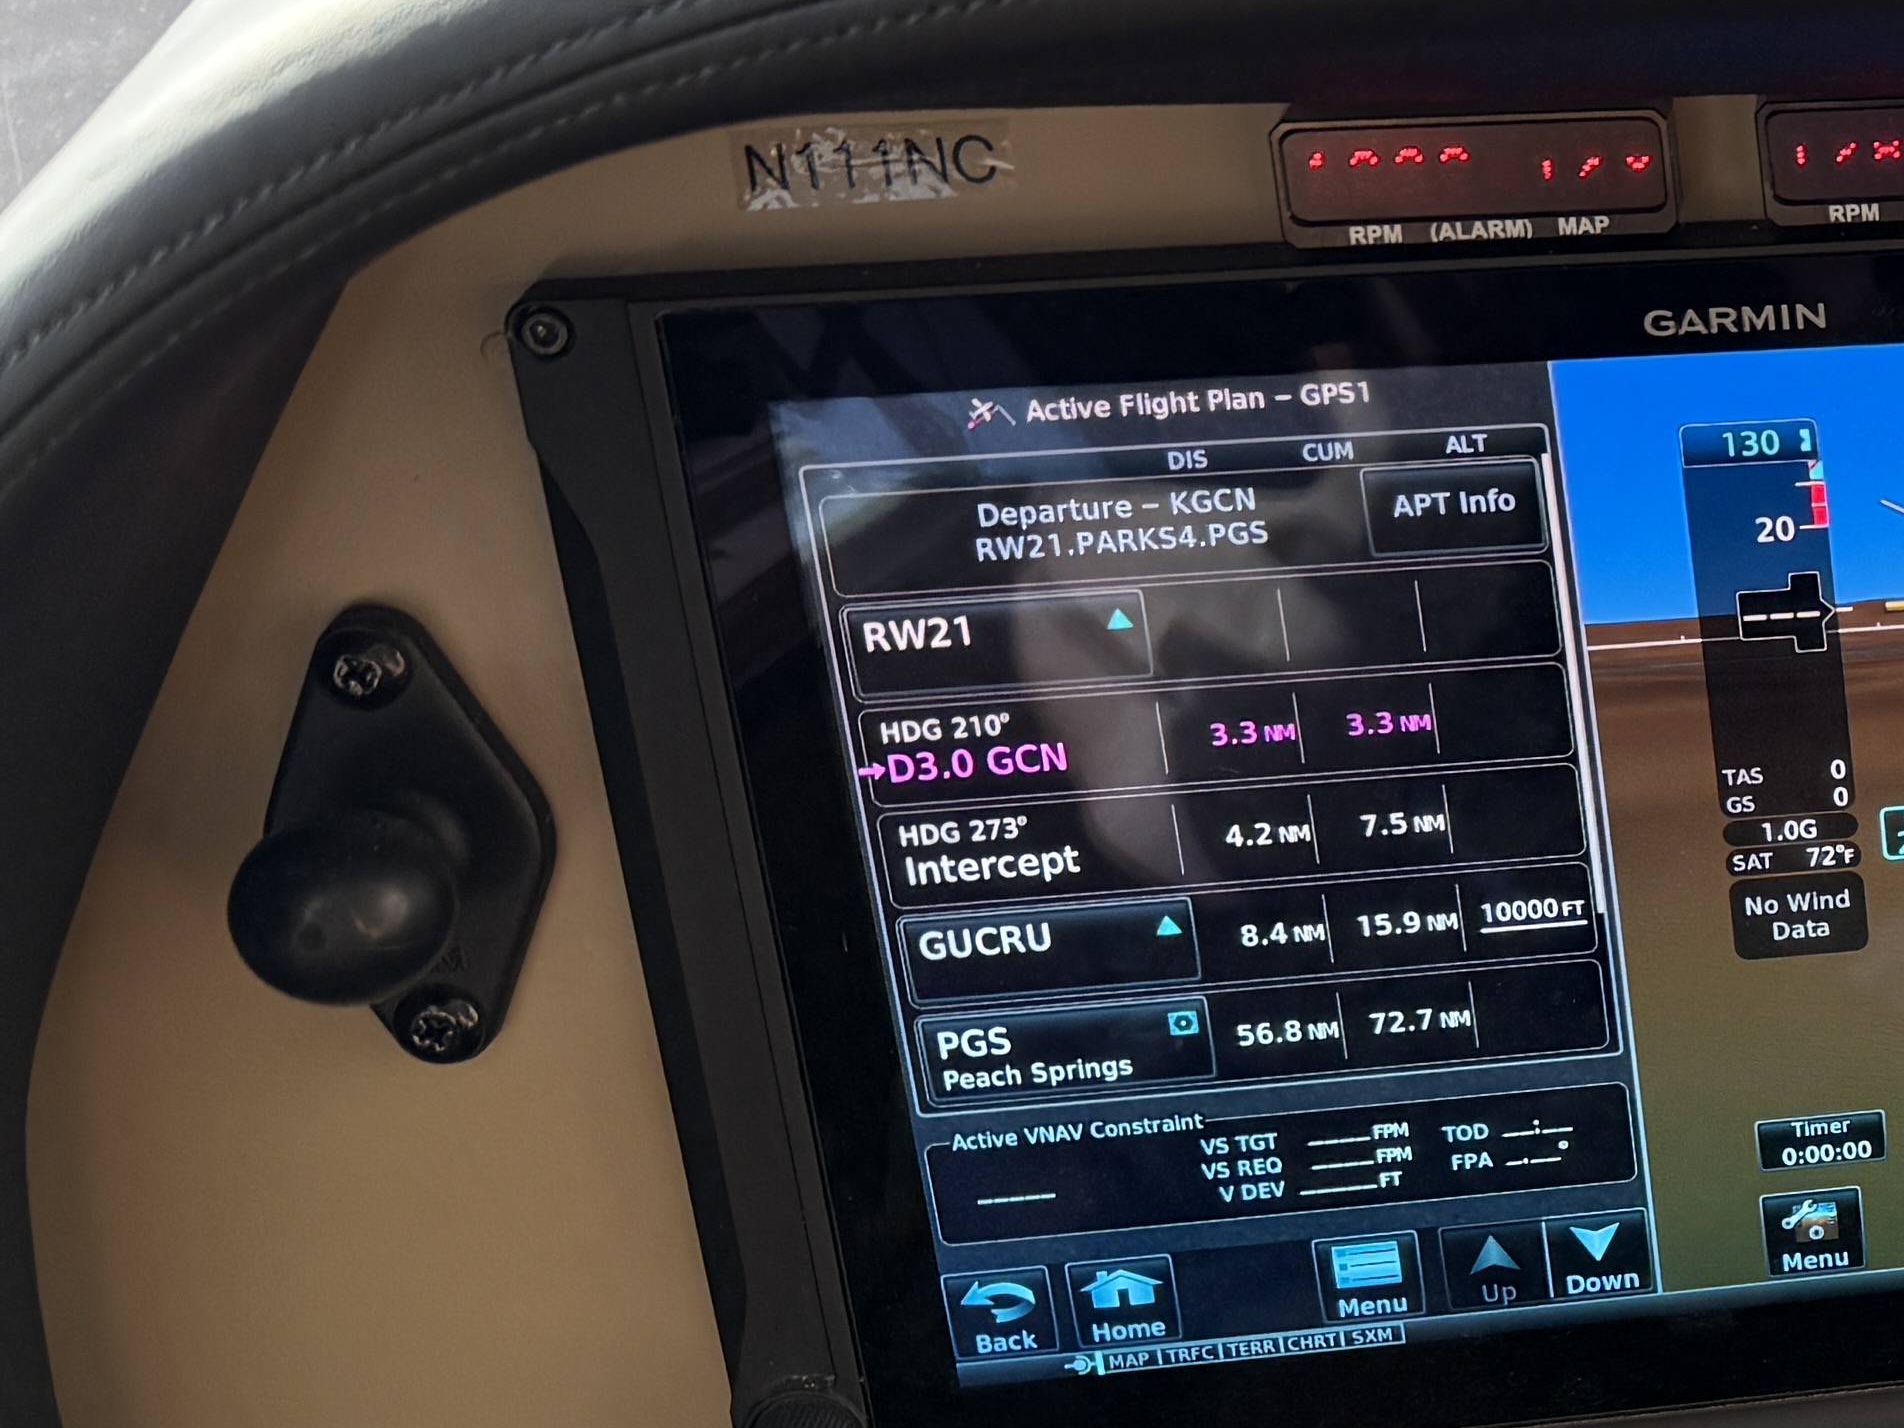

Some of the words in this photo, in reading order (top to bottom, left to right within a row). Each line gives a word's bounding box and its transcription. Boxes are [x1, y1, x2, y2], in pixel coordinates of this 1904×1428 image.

[743, 136, 1000, 195] N111NC
[1829, 203, 1880, 222] RPM
[1349, 223, 1403, 245] RPM
[1430, 217, 1534, 244] (ALARM)
[1558, 215, 1610, 237] MAP
[1641, 300, 1828, 338] GARMIN
[1026, 398, 1112, 423] Active
[1118, 390, 1200, 420] Flight
[1207, 387, 1266, 412] Plan
[1301, 382, 1371, 407] GPS1
[1168, 450, 1208, 471] DIS
[1302, 442, 1355, 463] CUM
[1446, 433, 1488, 454] ALT
[1722, 430, 1780, 457] 130
[977, 496, 1133, 528] Departure
[1170, 488, 1256, 513] KGCN
[1394, 492, 1450, 517] APT
[1459, 488, 1516, 513] Info
[976, 522, 1268, 563] RW21.PARKS4.PGS
[864, 619, 972, 653] RW21
[880, 719, 945, 743] HDG
[953, 713, 1010, 738] 210°
[888, 751, 974, 783] D3.0
[987, 744, 1068, 773] GCN
[905, 844, 1081, 887] Intercept
[1744, 893, 1783, 916] No
[1790, 888, 1849, 914] Wind
[919, 924, 1053, 961] GUCRU
[1772, 915, 1829, 942] Data
[937, 1027, 1012, 1060] PGS
[944, 1065, 1022, 1090] Peach
[1030, 1055, 1133, 1086] Springs
[951, 1129, 1018, 1152] Active
[1025, 1122, 1083, 1144] VNAV
[1090, 1113, 1205, 1140] Constraint
[1792, 1118, 1850, 1137] Timer
[1782, 1140, 1873, 1164] 0:00:00
[1566, 1269, 1640, 1293] Down
[1338, 1293, 1408, 1317] Menu
[976, 1330, 1038, 1353] Back
[1092, 1317, 1166, 1341] Home
